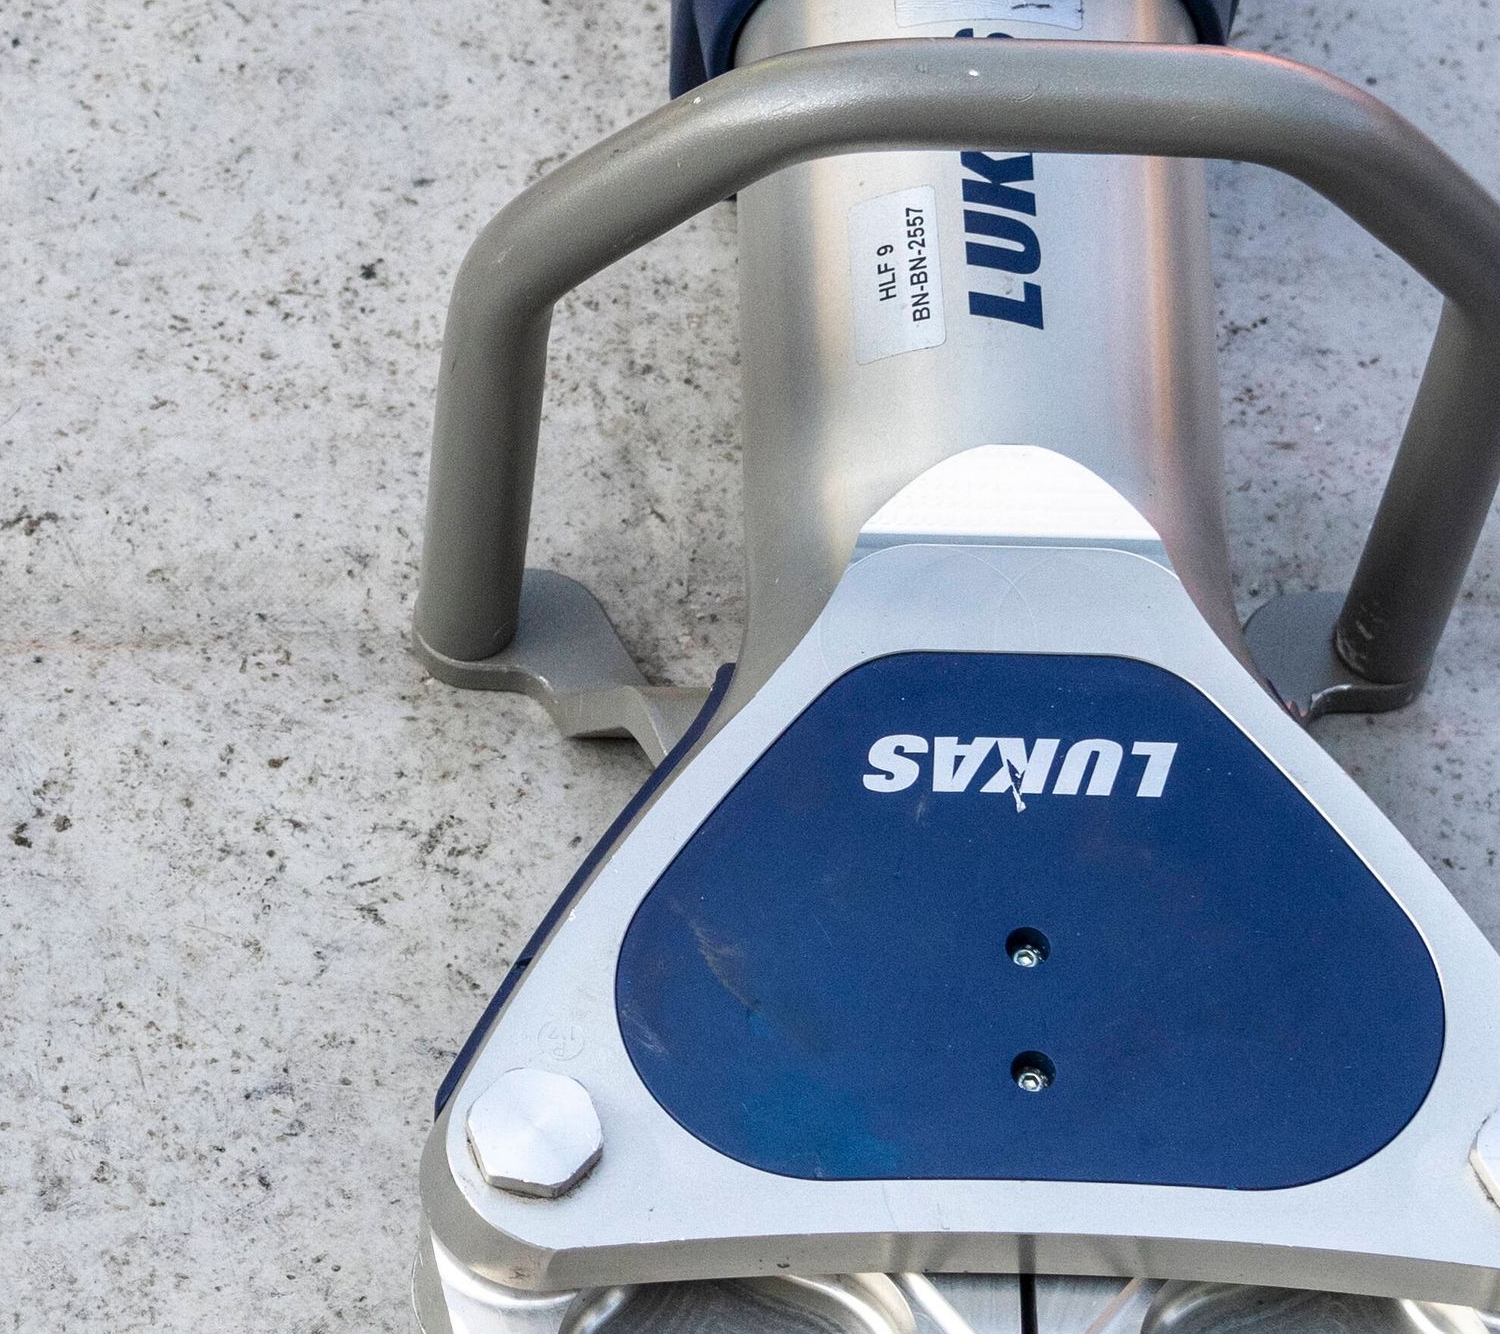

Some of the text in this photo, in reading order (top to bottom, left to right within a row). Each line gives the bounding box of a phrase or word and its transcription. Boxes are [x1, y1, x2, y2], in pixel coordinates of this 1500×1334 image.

[877, 243, 897, 302] HLF 9
[905, 207, 931, 323] BN-BN-2557
[863, 734, 1179, 798] LUKAS
